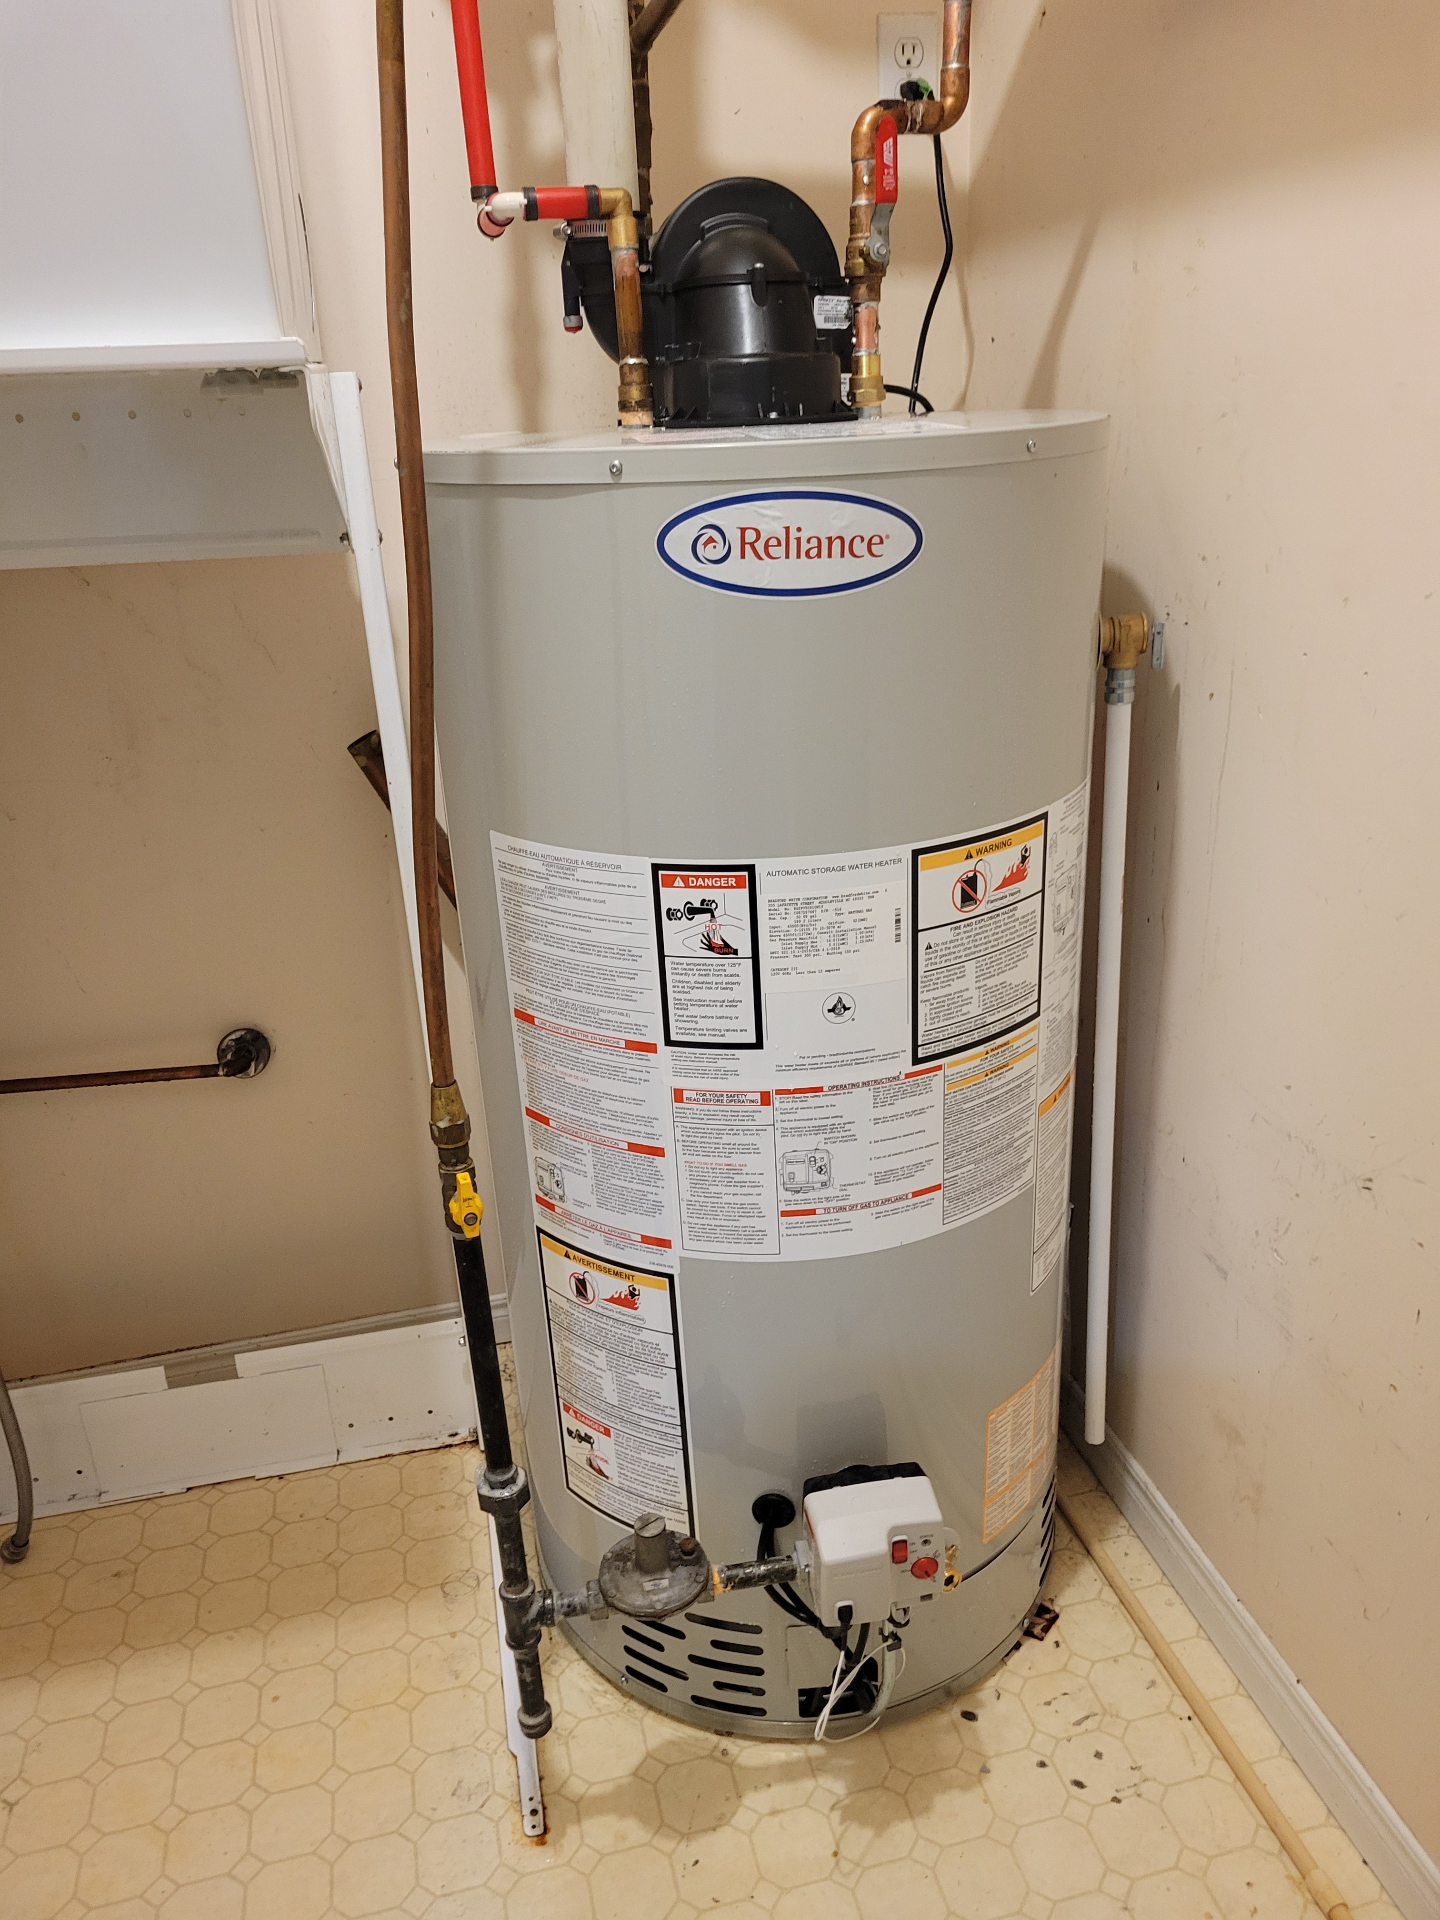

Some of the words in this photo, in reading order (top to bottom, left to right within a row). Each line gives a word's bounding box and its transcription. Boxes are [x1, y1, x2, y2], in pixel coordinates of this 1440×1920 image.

[736, 526, 884, 561] Reliance
[975, 838, 1012, 856] WARNING
[541, 853, 579, 865] AUTOMATIQUE
[586, 860, 622, 870] RÉSERVOIR
[767, 868, 809, 877] AUTOMATIC
[812, 866, 846, 874] STORAGE
[848, 862, 873, 871] WATER
[875, 858, 902, 868] HEATER
[689, 876, 736, 887] DANGER
[974, 913, 1000, 926] EXPLOSION
[1001, 906, 1018, 918] HAZARD
[861, 1075, 901, 1087] INSTRUCTIONS
[882, 1194, 909, 1205] APPLIANCE
[572, 1254, 635, 1282] AVERTISSEMENT
[577, 1413, 605, 1433] DANGER
